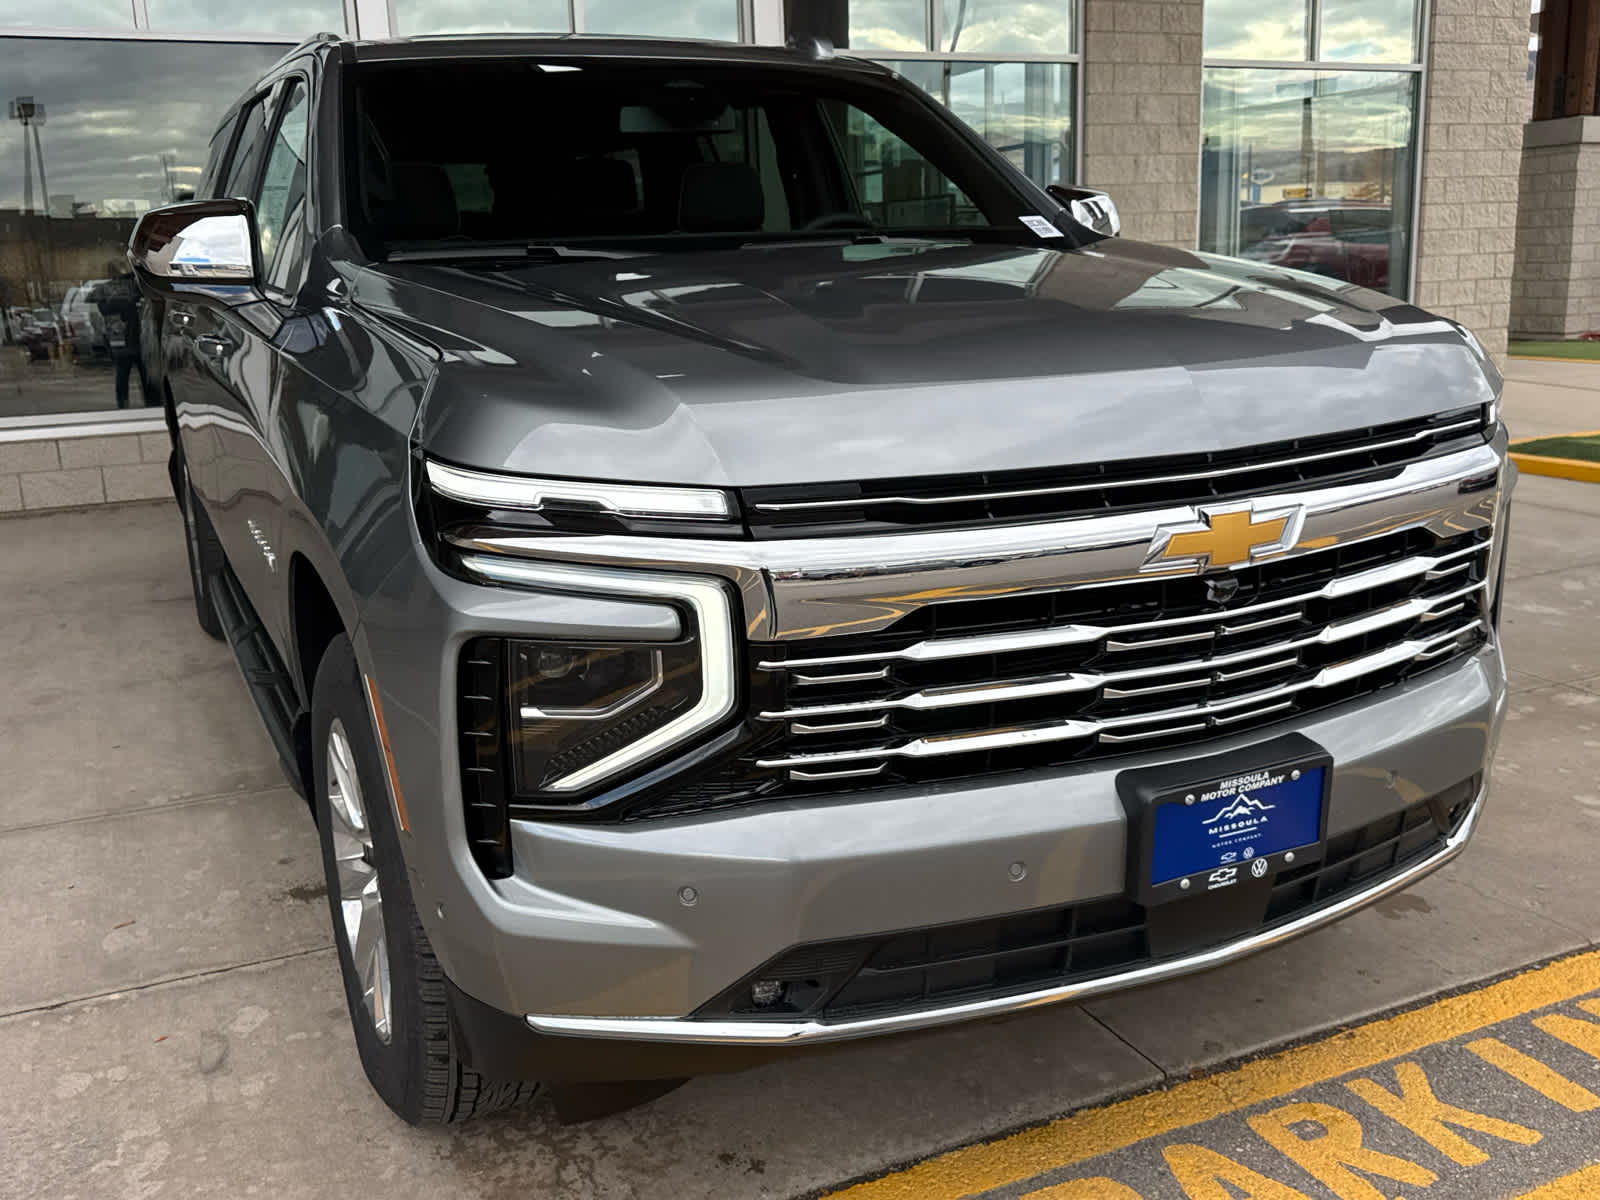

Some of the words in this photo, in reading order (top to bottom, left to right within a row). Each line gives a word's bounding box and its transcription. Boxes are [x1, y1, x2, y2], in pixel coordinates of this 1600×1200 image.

[1201, 787, 1236, 802] MOTOR
[1238, 775, 1286, 793] COMPANY
[1219, 772, 1269, 790] MISSOULA
[1208, 816, 1268, 835] MISSOULA
